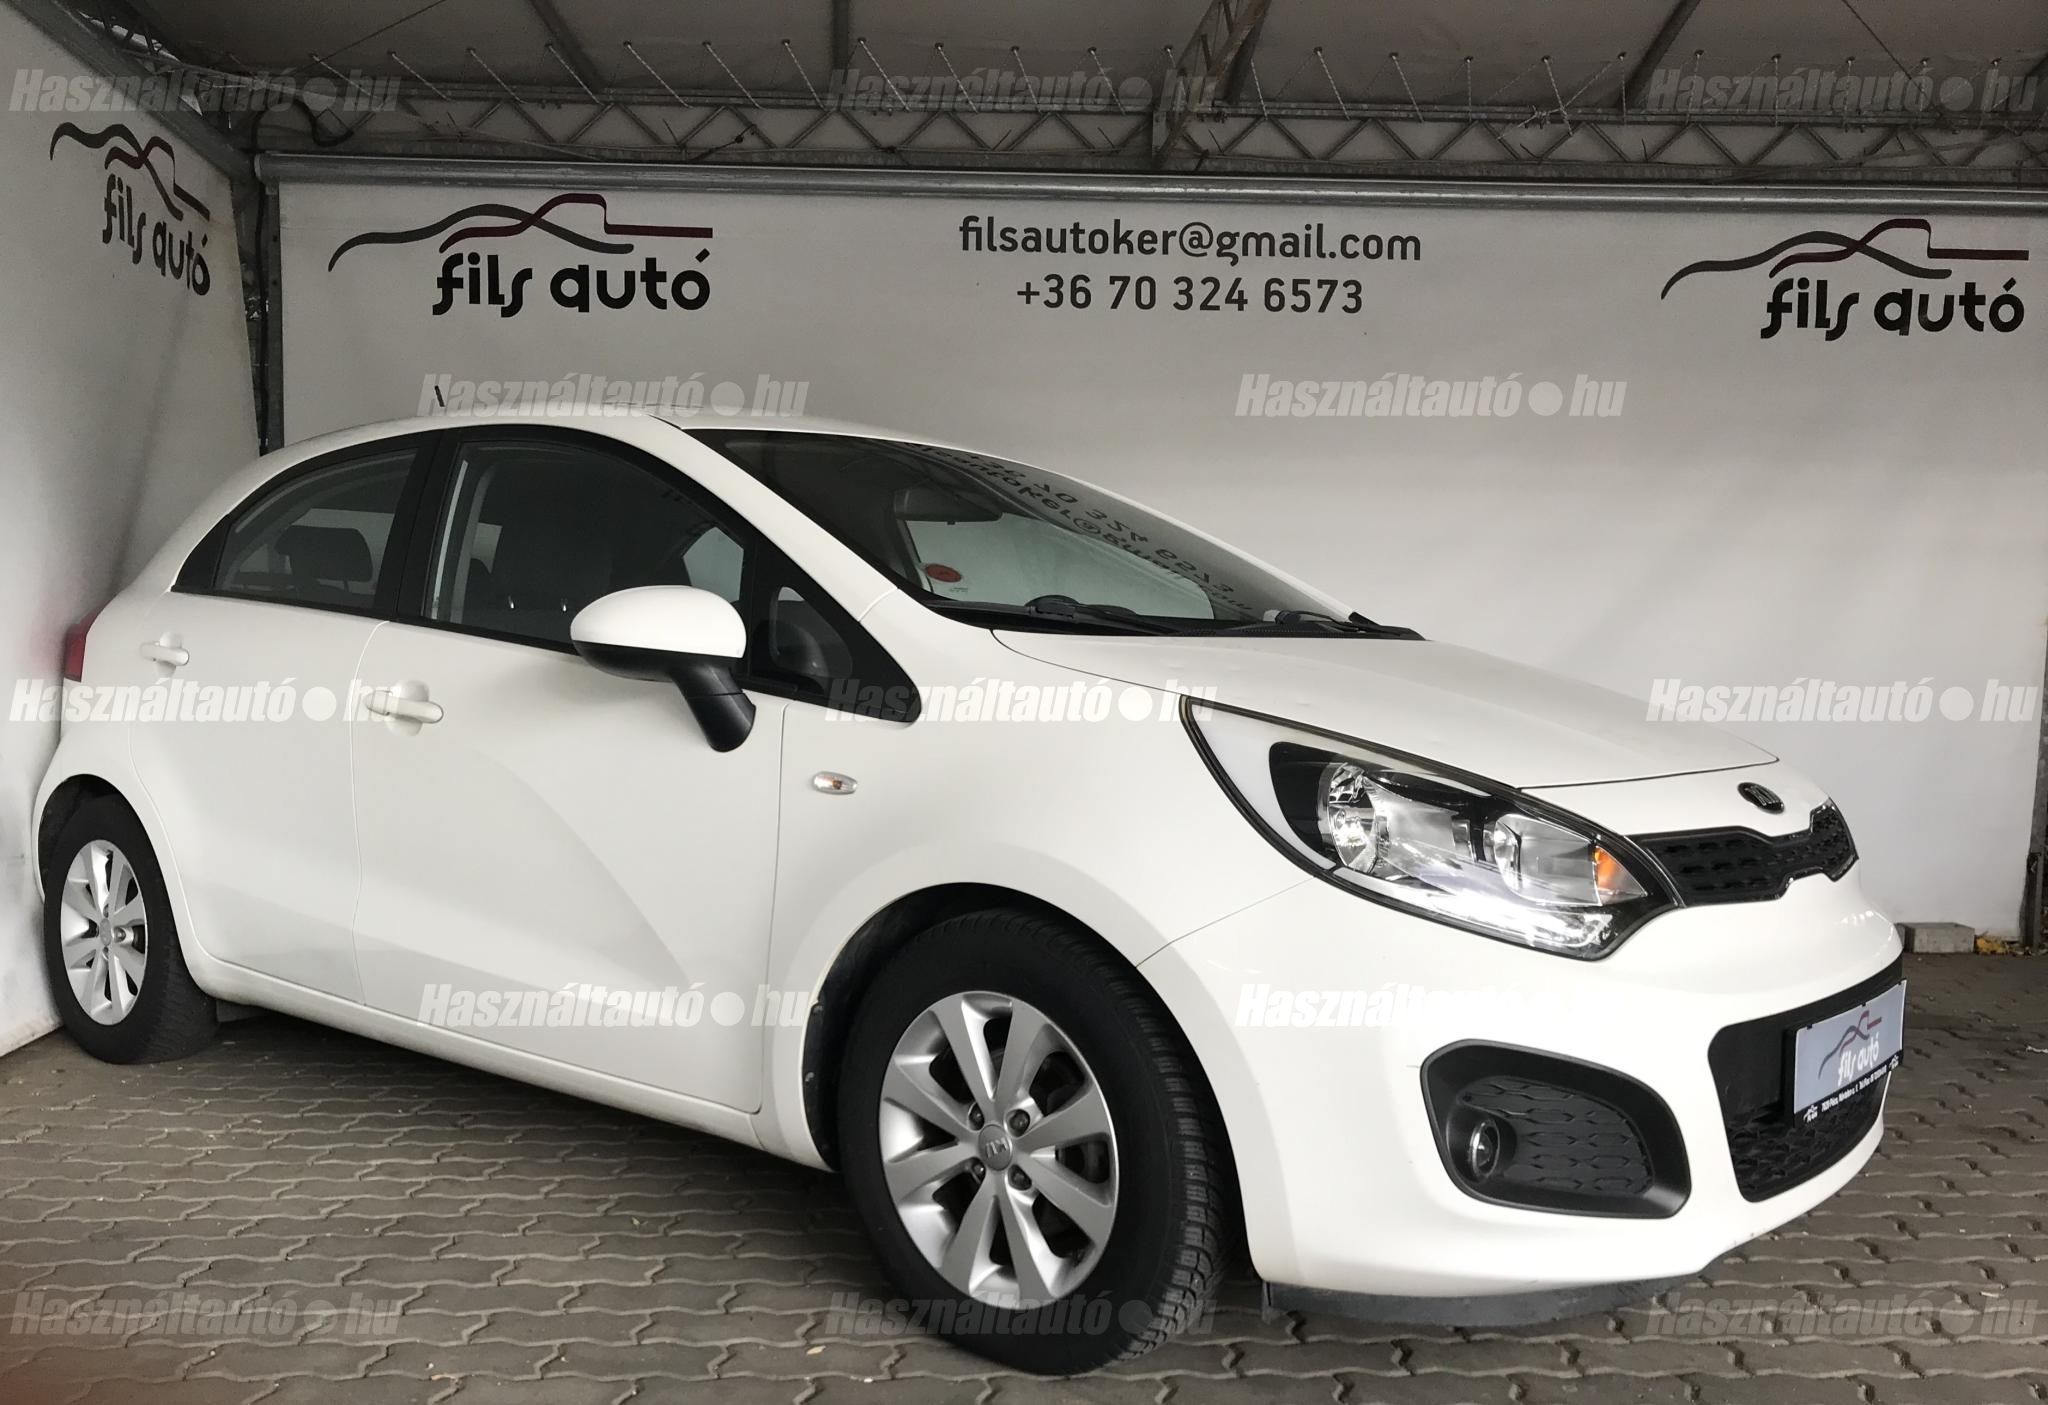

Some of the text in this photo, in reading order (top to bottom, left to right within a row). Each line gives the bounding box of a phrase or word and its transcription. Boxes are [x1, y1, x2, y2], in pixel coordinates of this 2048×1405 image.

[103, 174, 210, 295] fils autó
[959, 216, 1422, 267] filsautoker@gmail.com
[433, 248, 711, 318] fils autó
[1017, 275, 1363, 314] +36 70 324 6573
[1760, 277, 2025, 341] fils autó
